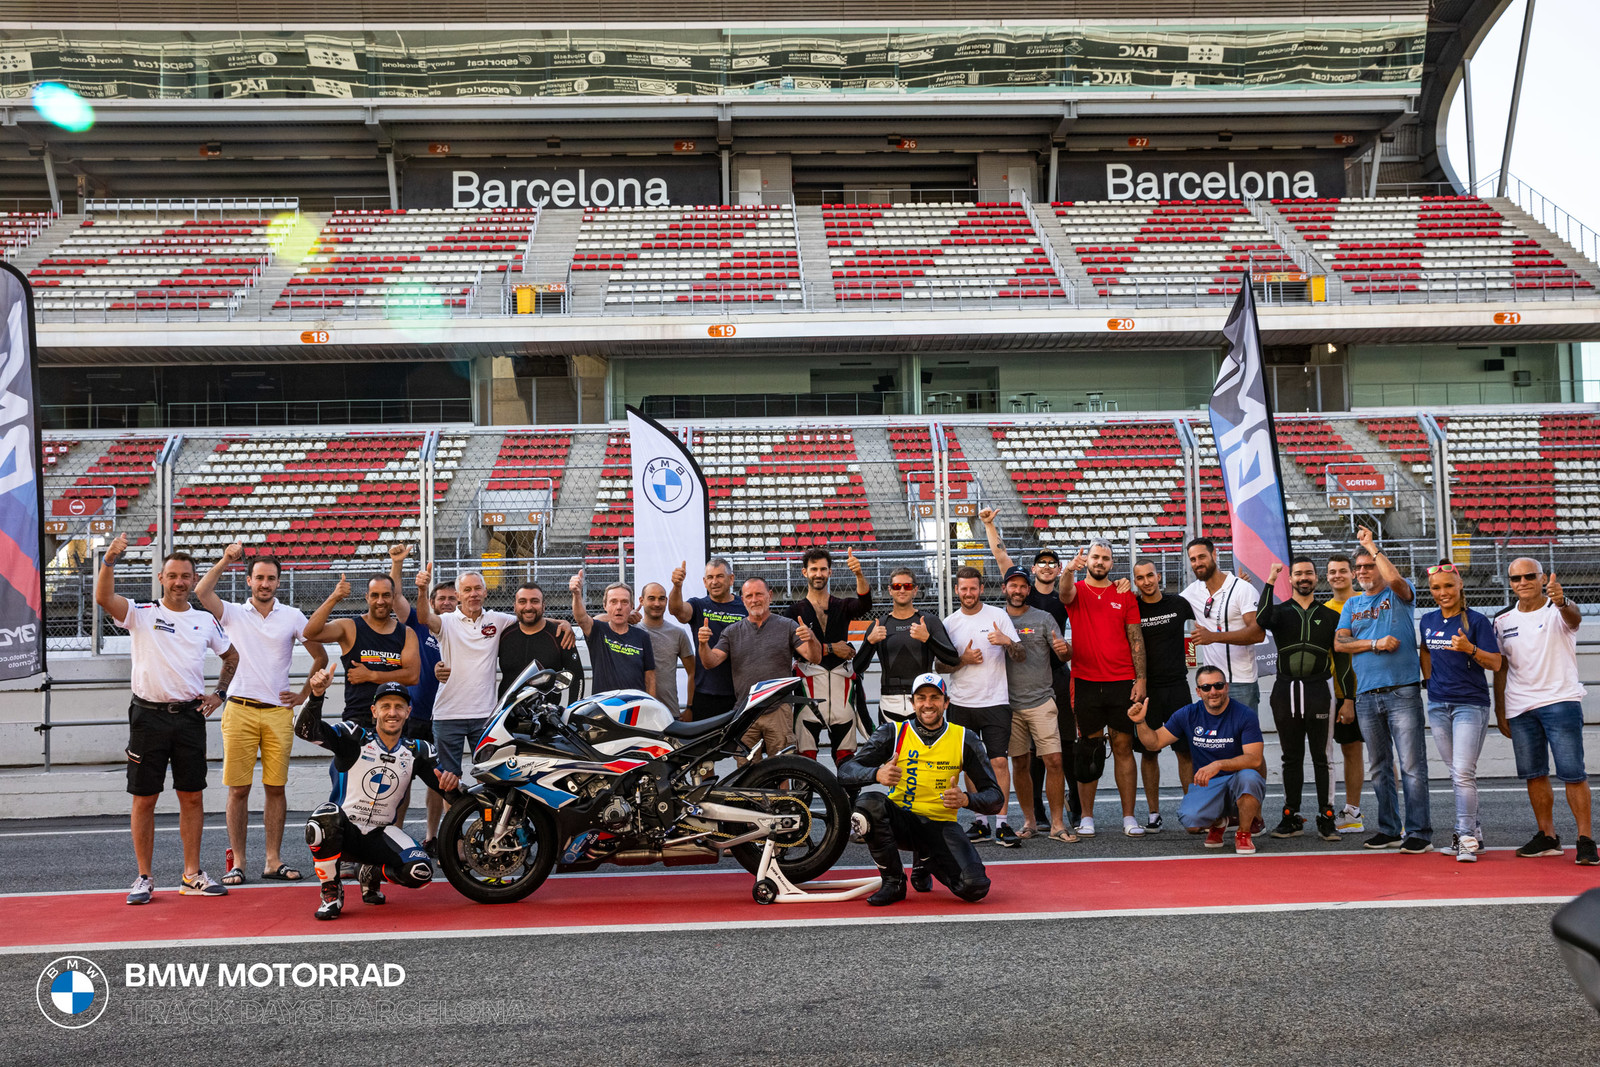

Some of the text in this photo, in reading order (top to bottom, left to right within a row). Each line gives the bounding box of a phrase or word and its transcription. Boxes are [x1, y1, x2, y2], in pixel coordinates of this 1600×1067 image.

[904, 140, 918, 150] 26
[1136, 138, 1148, 146] 27
[1342, 136, 1354, 144] 28
[436, 144, 448, 153] 24
[682, 142, 694, 150] 25
[1106, 162, 1318, 200] Barcelona
[452, 169, 670, 208] Barcelona
[1504, 314, 1518, 324] 21
[1117, 320, 1132, 330] 20
[719, 326, 734, 336] 19
[312, 332, 327, 342] 18
[1150, 612, 1178, 620] MOTORRAD
[1141, 619, 1170, 628] OTORSPORT
[360, 650, 400, 660] QUIKSILVE
